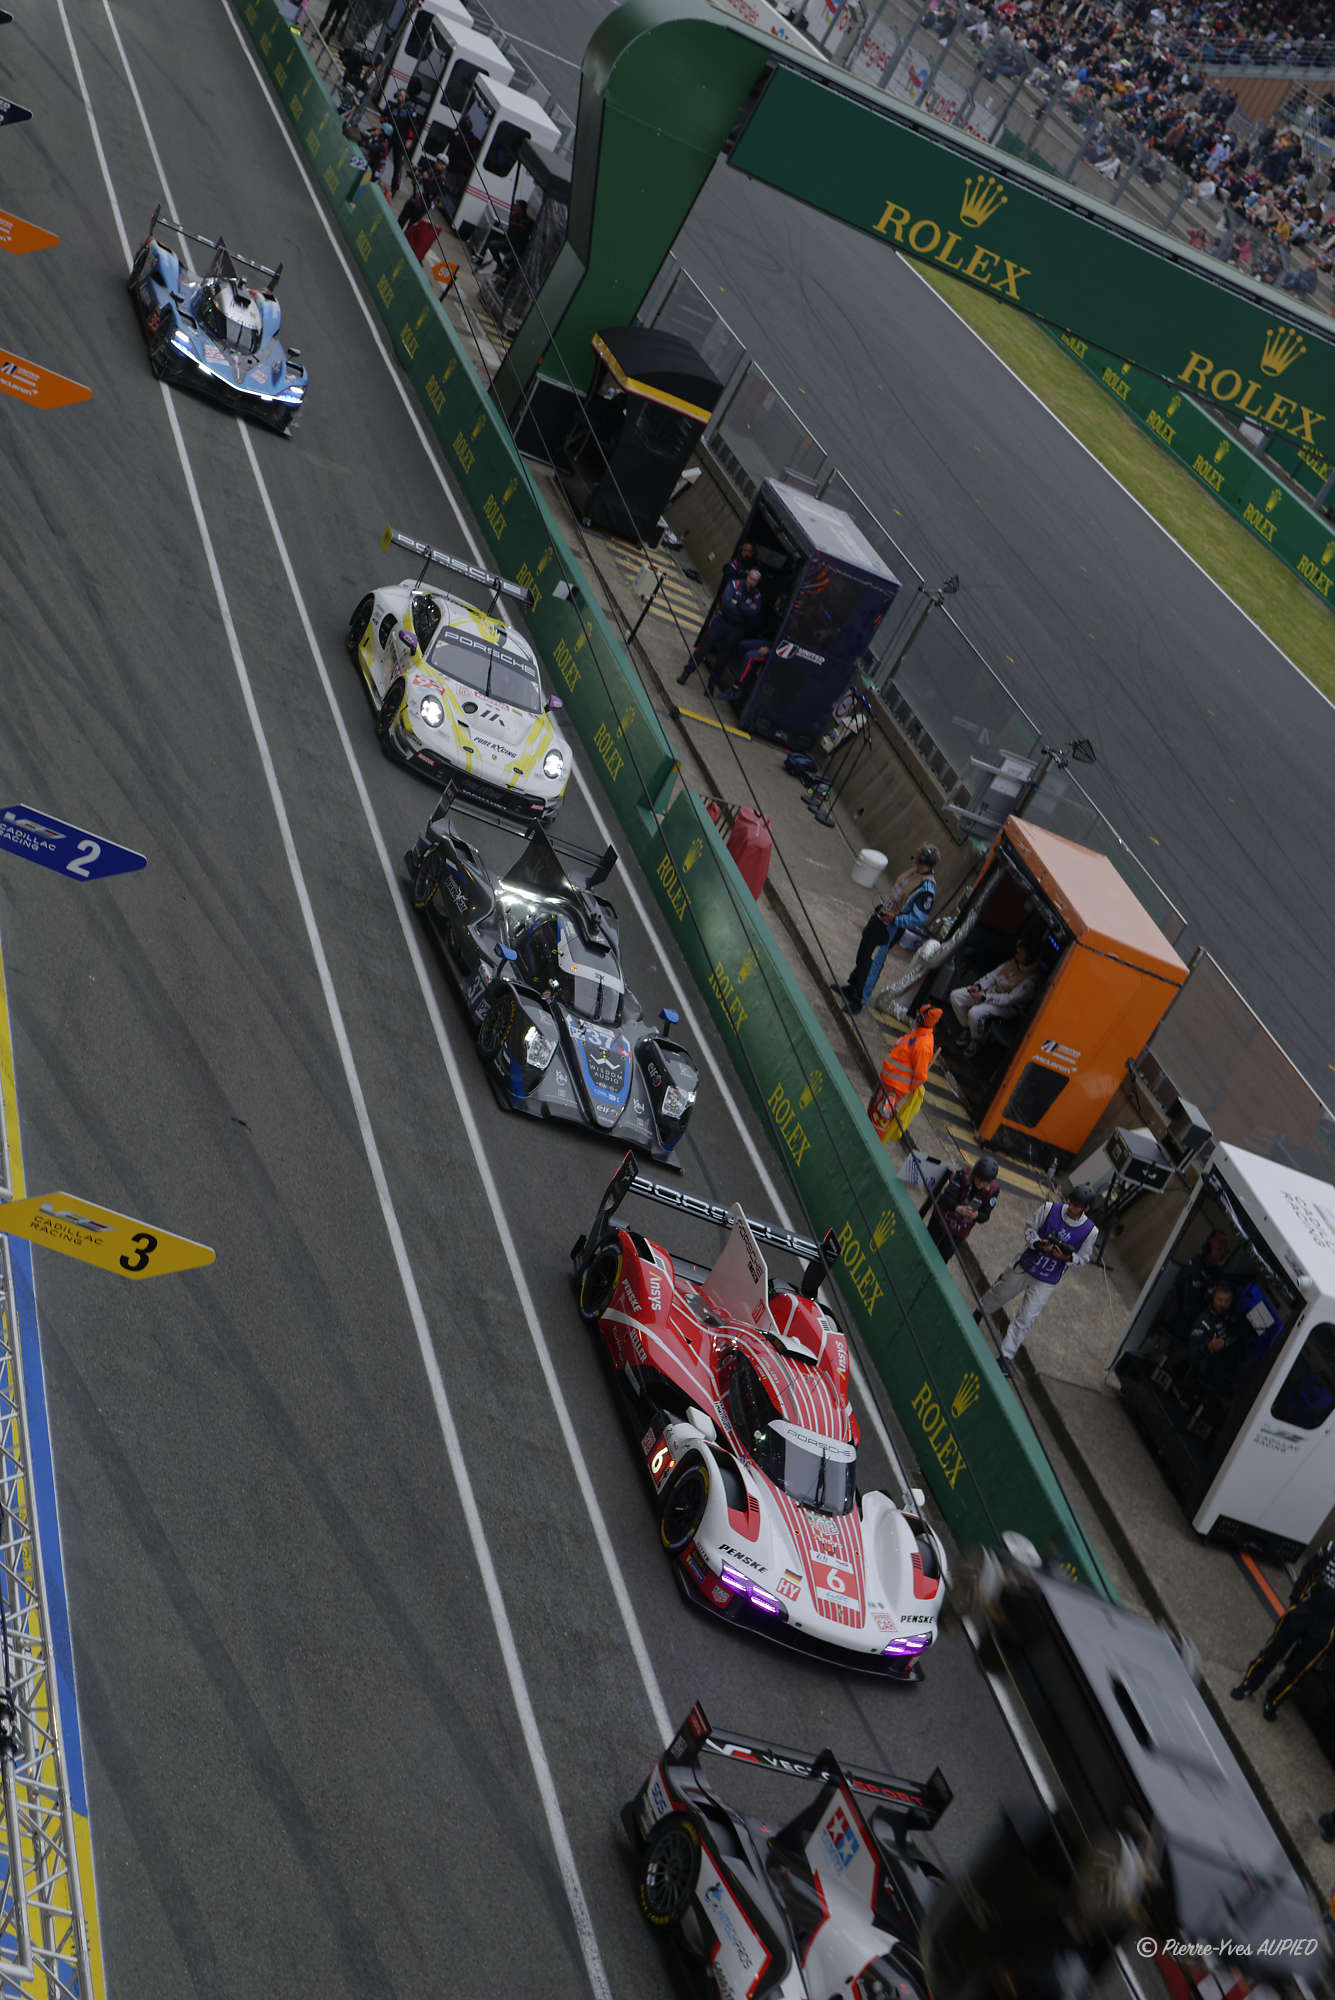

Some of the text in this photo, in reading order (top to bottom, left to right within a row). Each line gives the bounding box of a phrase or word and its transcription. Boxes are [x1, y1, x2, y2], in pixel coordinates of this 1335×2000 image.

[872, 200, 1031, 301] ROLEX
[400, 322, 420, 359] ROLEX
[426, 374, 446, 415] ROLEX
[1102, 367, 1132, 401] ROLEX
[1177, 351, 1327, 446] ROLEX
[1146, 409, 1176, 445] ROLEX
[452, 432, 475, 474] ROLEX
[1192, 454, 1225, 492] ROLEX
[483, 494, 507, 541] ROLEX
[1242, 503, 1278, 543] ROLEX
[398, 533, 521, 595] PORSCHE
[1296, 554, 1334, 598] ROLEX
[444, 631, 536, 677] PORSCHE
[554, 639, 581, 694] ROLEX
[593, 722, 624, 782] ROLEX
[66, 839, 101, 878] 2
[656, 852, 692, 922] ROLEX
[708, 960, 748, 1034] ROLEX
[590, 1064, 622, 1080] WISDOM
[594, 1072, 619, 1084] AUDIO
[768, 1082, 811, 1167] ROLEX
[30, 1222, 84, 1246] RACING
[34, 1216, 104, 1245] CADILLAC
[120, 1233, 158, 1272] 3
[836, 1221, 884, 1318] ROLEX
[622, 1278, 642, 1313] PENSKE
[787, 1430, 852, 1458] PORSCHE
[912, 1380, 967, 1490] ROLEX
[652, 1446, 668, 1474] 6
[718, 1544, 768, 1574] PENSKE
[778, 1580, 800, 1598] HY
[827, 1568, 846, 1592] 6
[901, 1616, 934, 1624] PENSKE
[853, 1779, 925, 1807] SPORT
